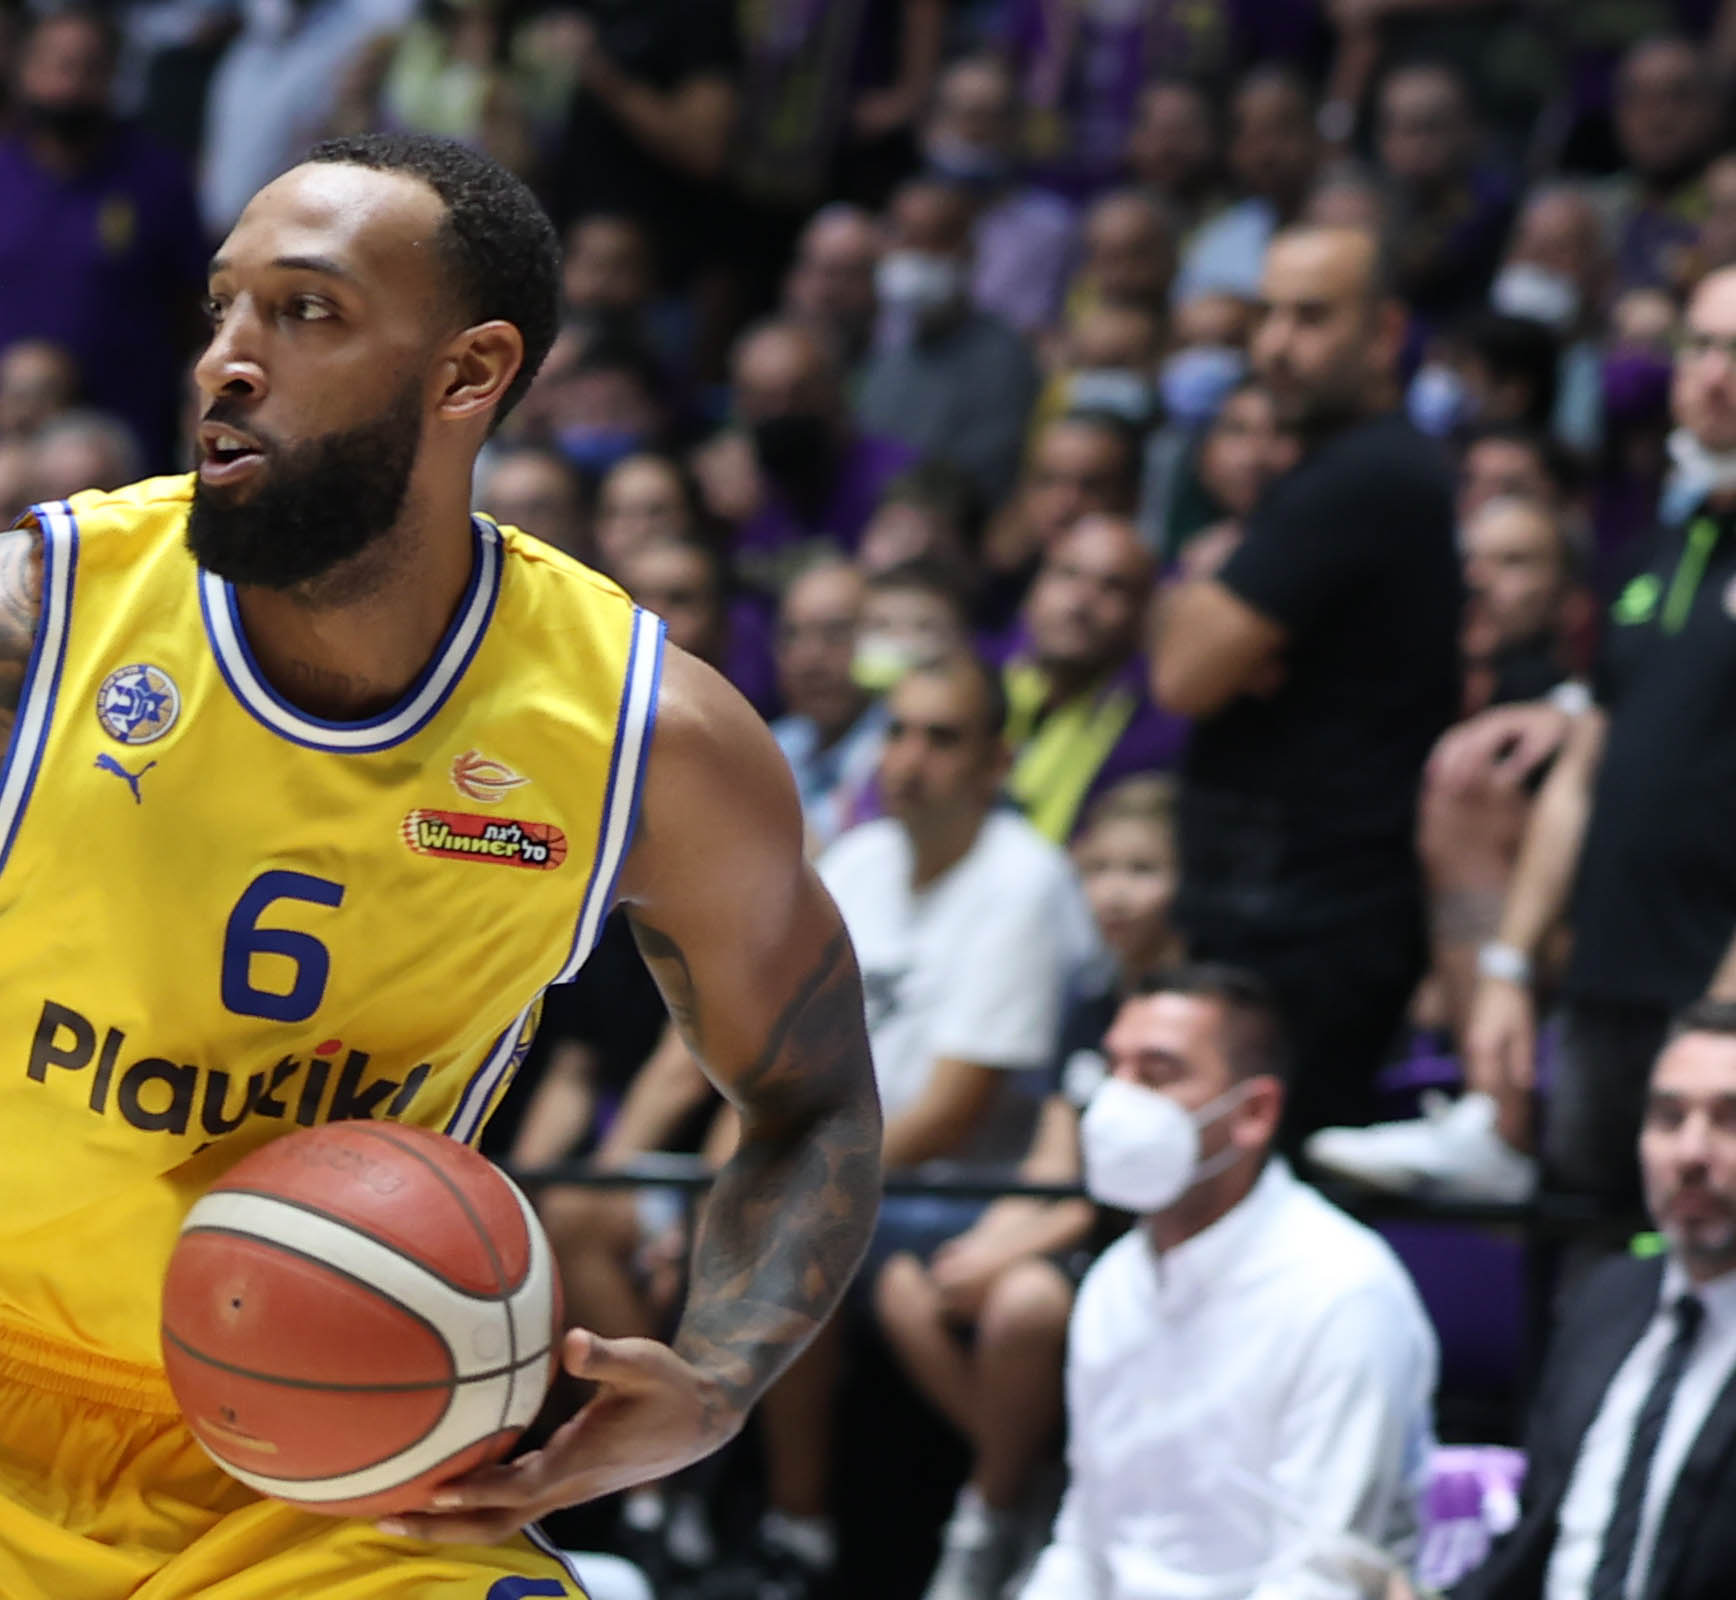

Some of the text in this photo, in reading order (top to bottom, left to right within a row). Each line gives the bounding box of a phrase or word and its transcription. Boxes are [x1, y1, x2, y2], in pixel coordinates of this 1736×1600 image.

[418, 821, 521, 857] Winner
[484, 823, 522, 841] ליגת
[220, 869, 345, 1024] 6
